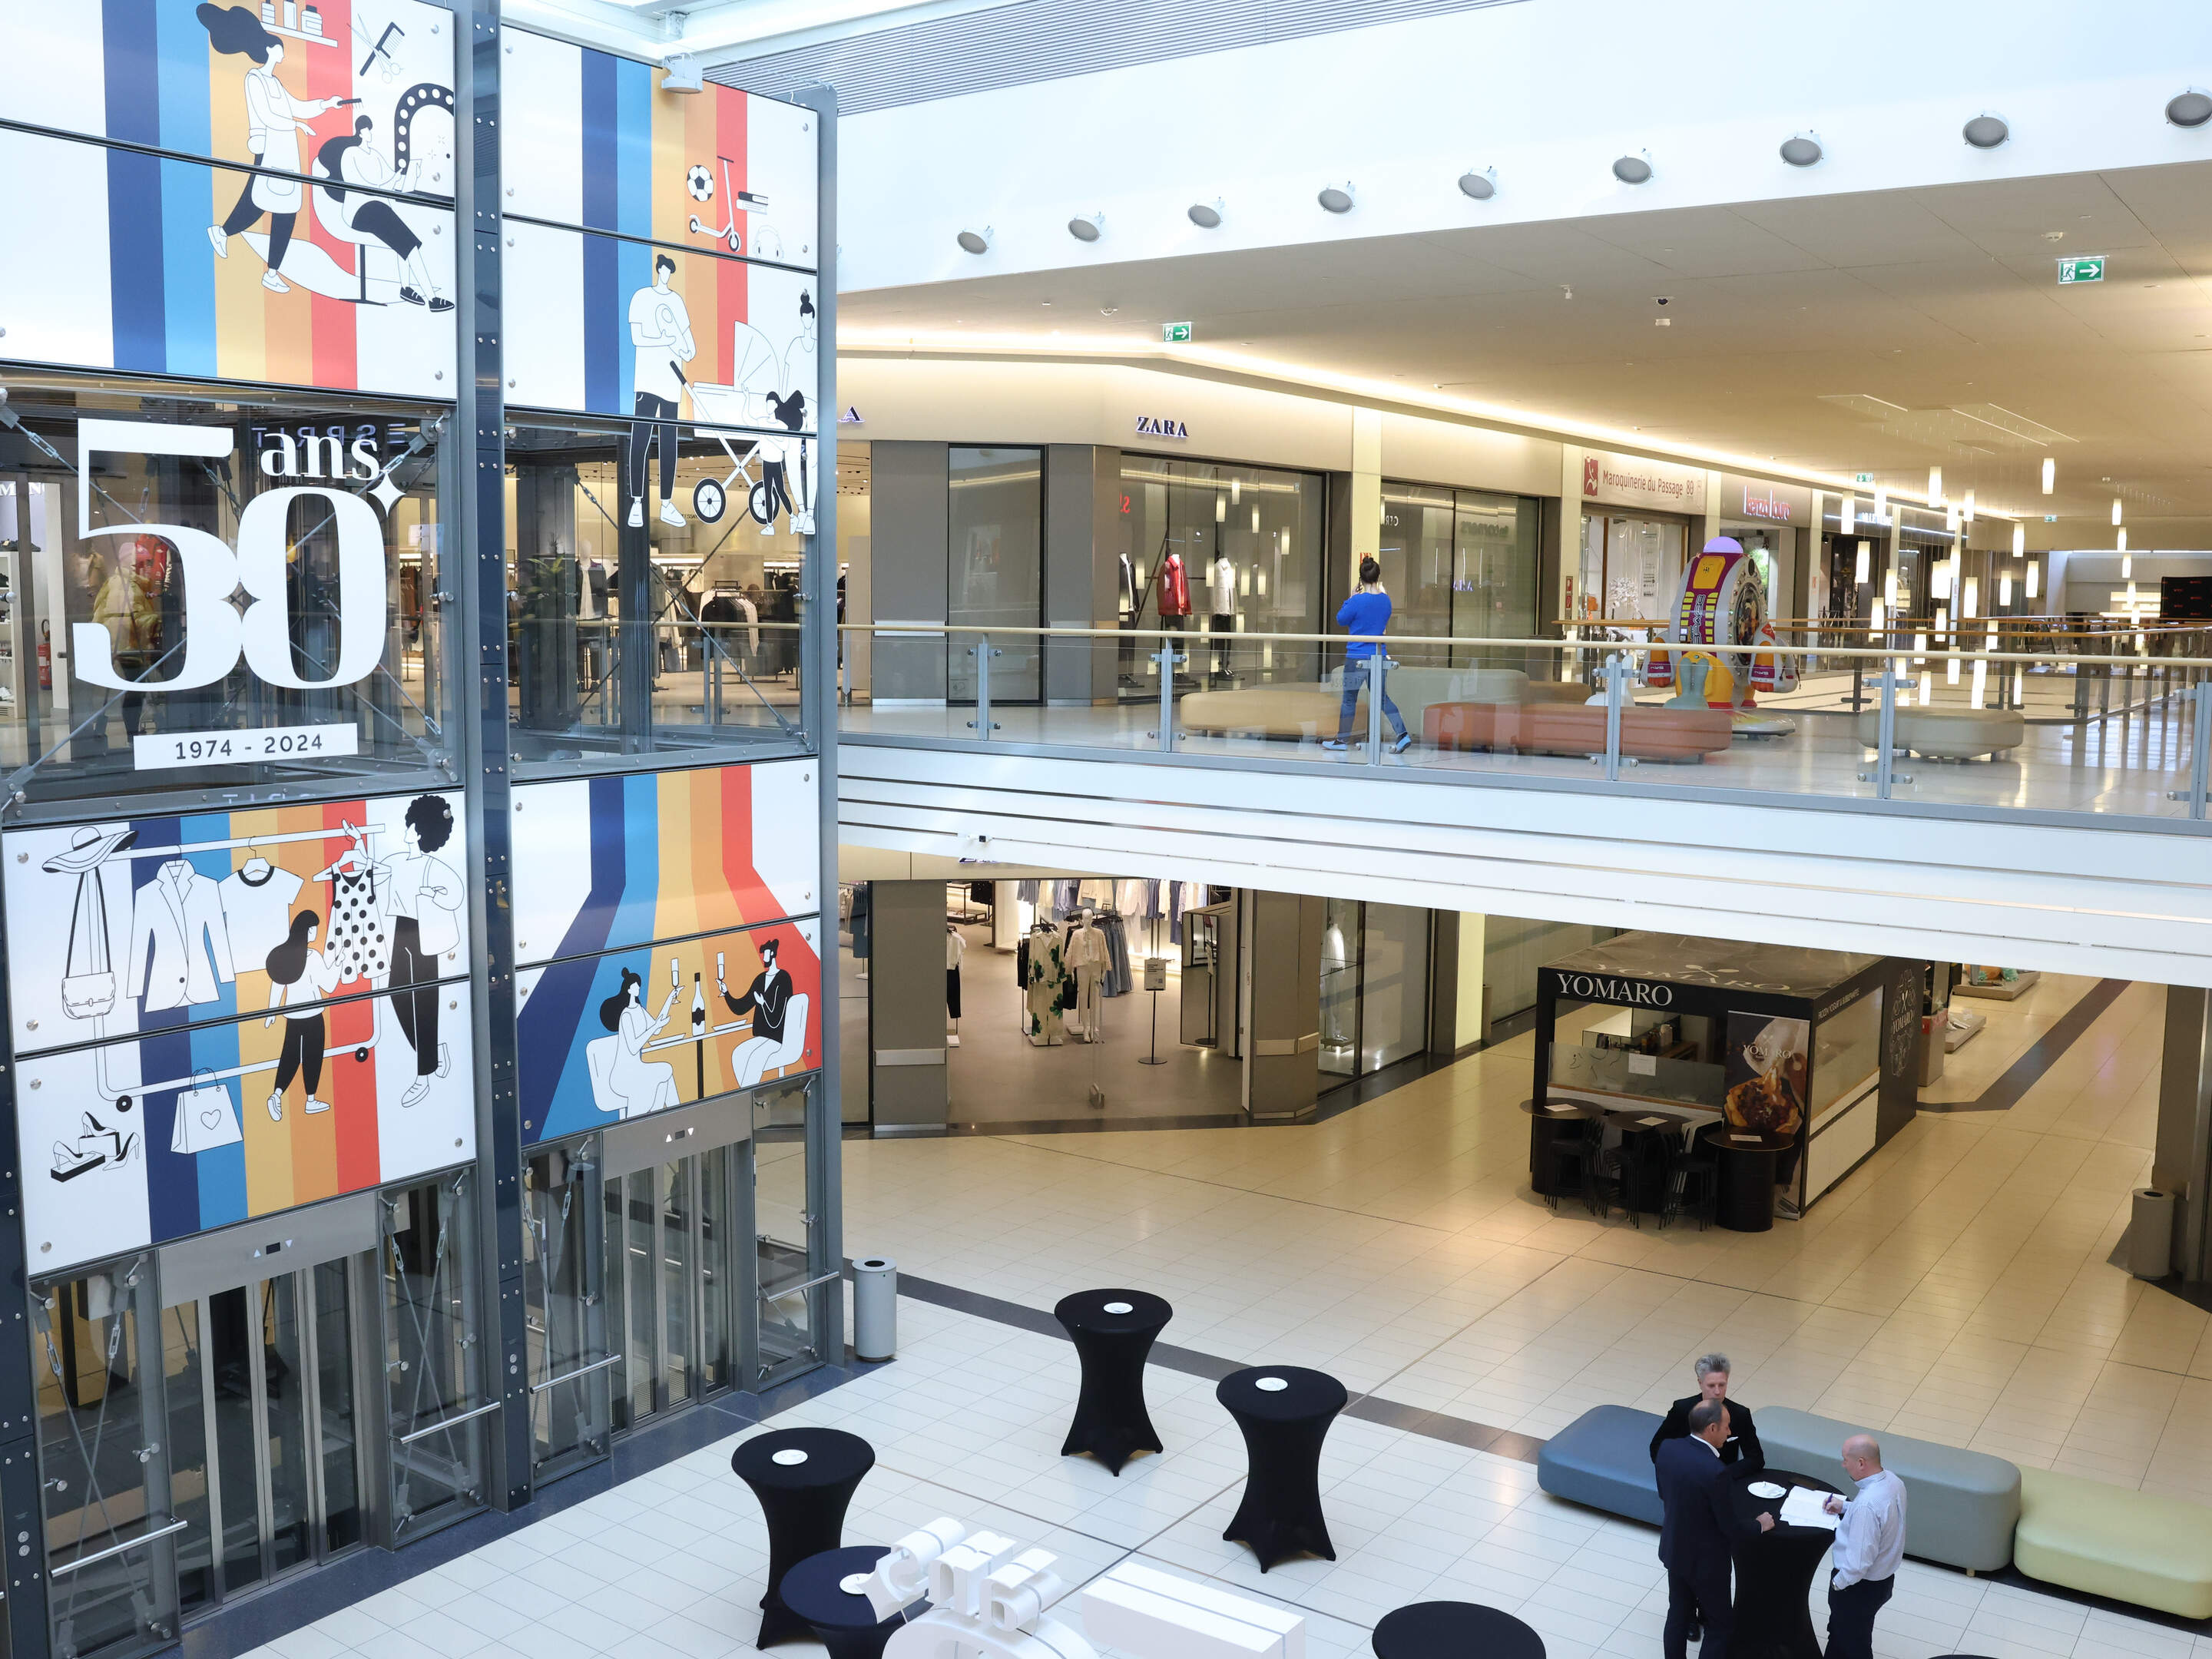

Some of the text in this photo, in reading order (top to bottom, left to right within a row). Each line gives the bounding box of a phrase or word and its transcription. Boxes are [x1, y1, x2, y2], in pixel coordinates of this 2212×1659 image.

[1137, 416, 1189, 438] ZARA
[1602, 469, 1646, 491] Maroquinerie
[1647, 475, 1656, 492] du
[1657, 478, 1684, 498] Passage
[72, 418, 387, 692] 50
[260, 432, 381, 480] ans
[175, 739, 232, 760] 1974
[264, 733, 323, 754] 2024
[1556, 972, 1674, 1006] YOMARO
